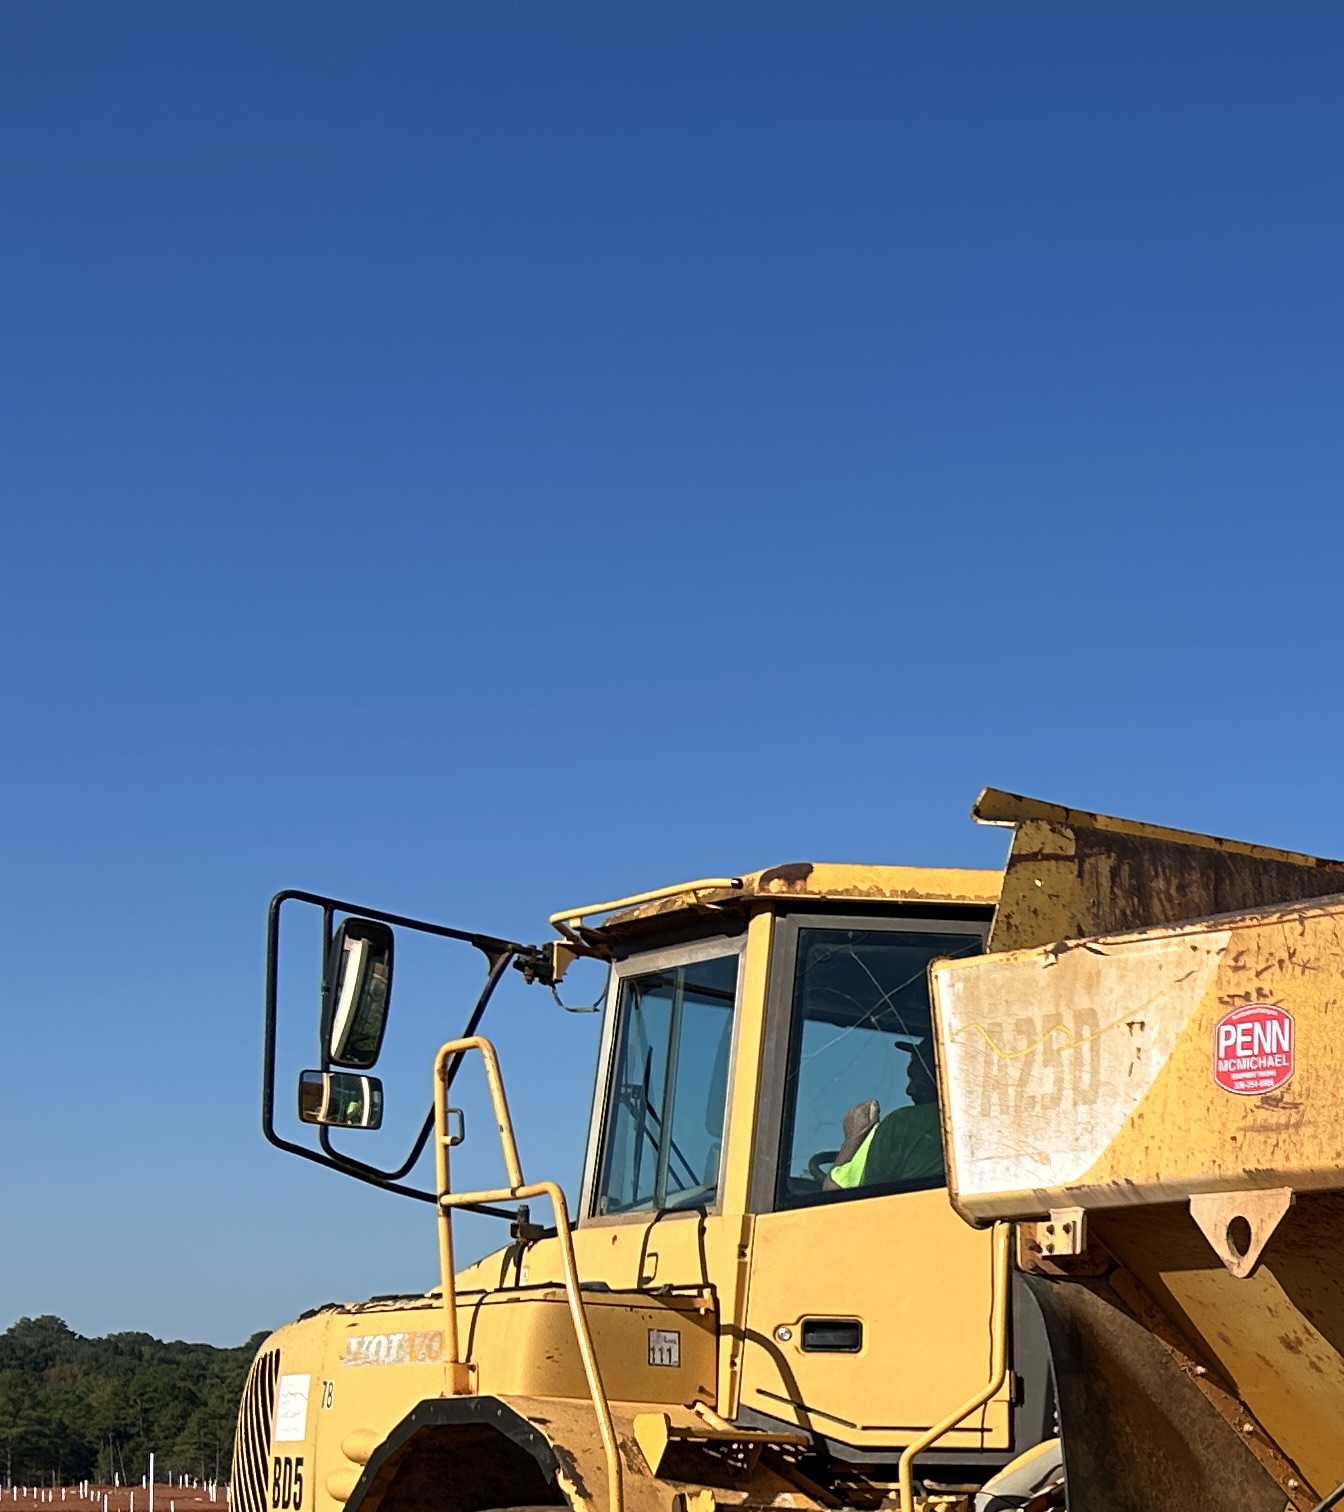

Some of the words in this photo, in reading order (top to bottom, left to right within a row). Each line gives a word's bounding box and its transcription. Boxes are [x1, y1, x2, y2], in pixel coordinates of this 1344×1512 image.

[1218, 1018, 1290, 1058] PENN
[1217, 1054, 1290, 1072] MCMICHAEL
[272, 1456, 304, 1511] BD5
